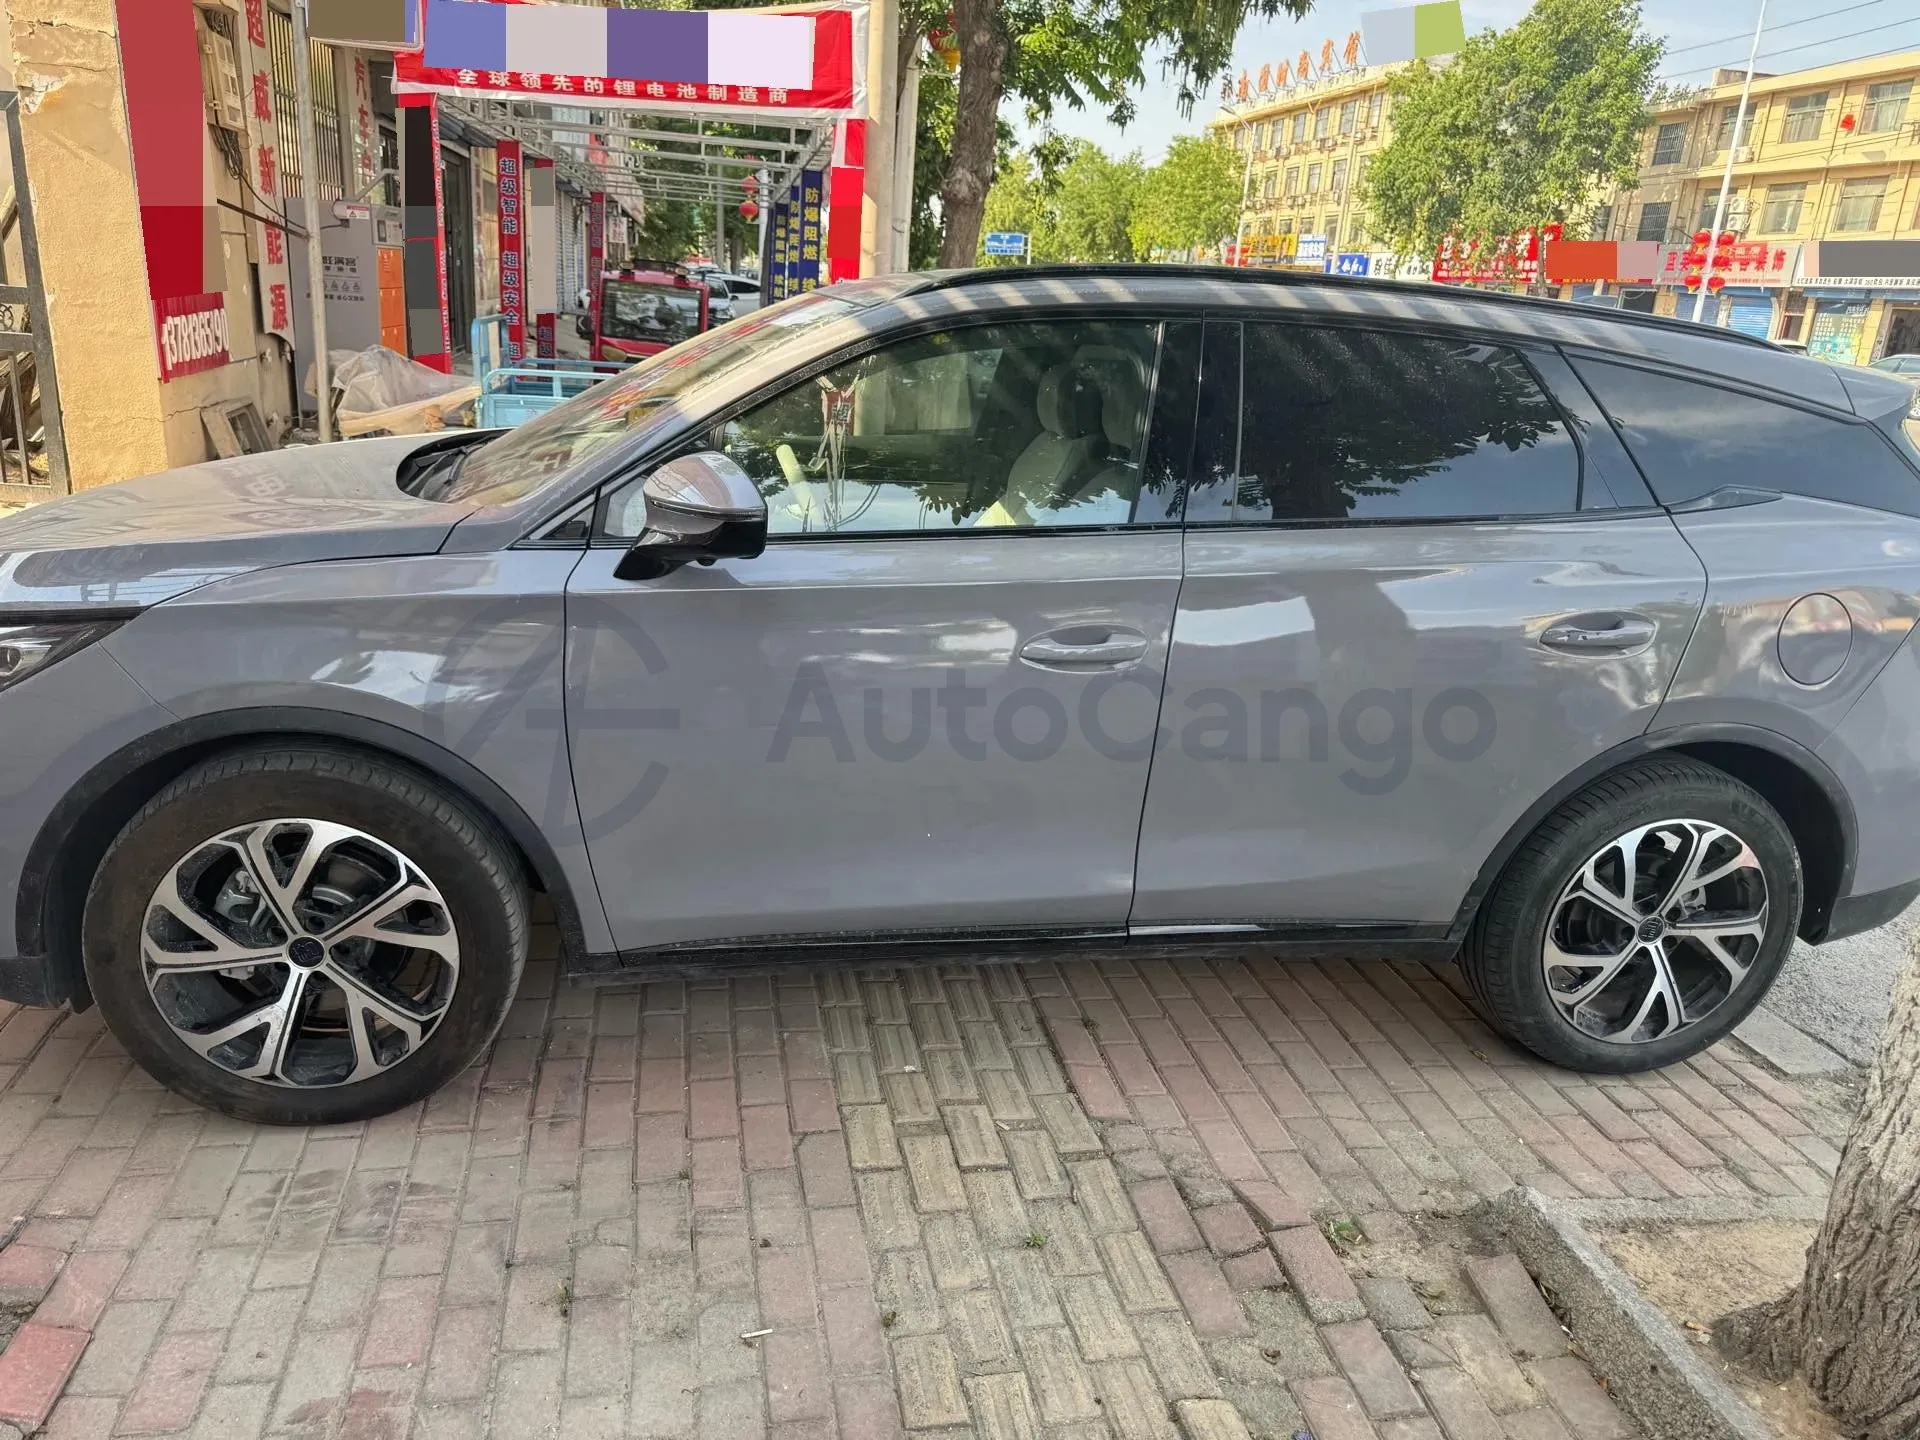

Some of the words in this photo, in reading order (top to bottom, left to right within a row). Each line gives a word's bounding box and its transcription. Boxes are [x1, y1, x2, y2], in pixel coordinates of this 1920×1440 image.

[457, 68, 788, 104] 全球领先的锂电池制造商
[500, 158, 517, 235] 超级智能
[503, 252, 520, 326] 超级安全
[161, 308, 229, 371] 13781365190
